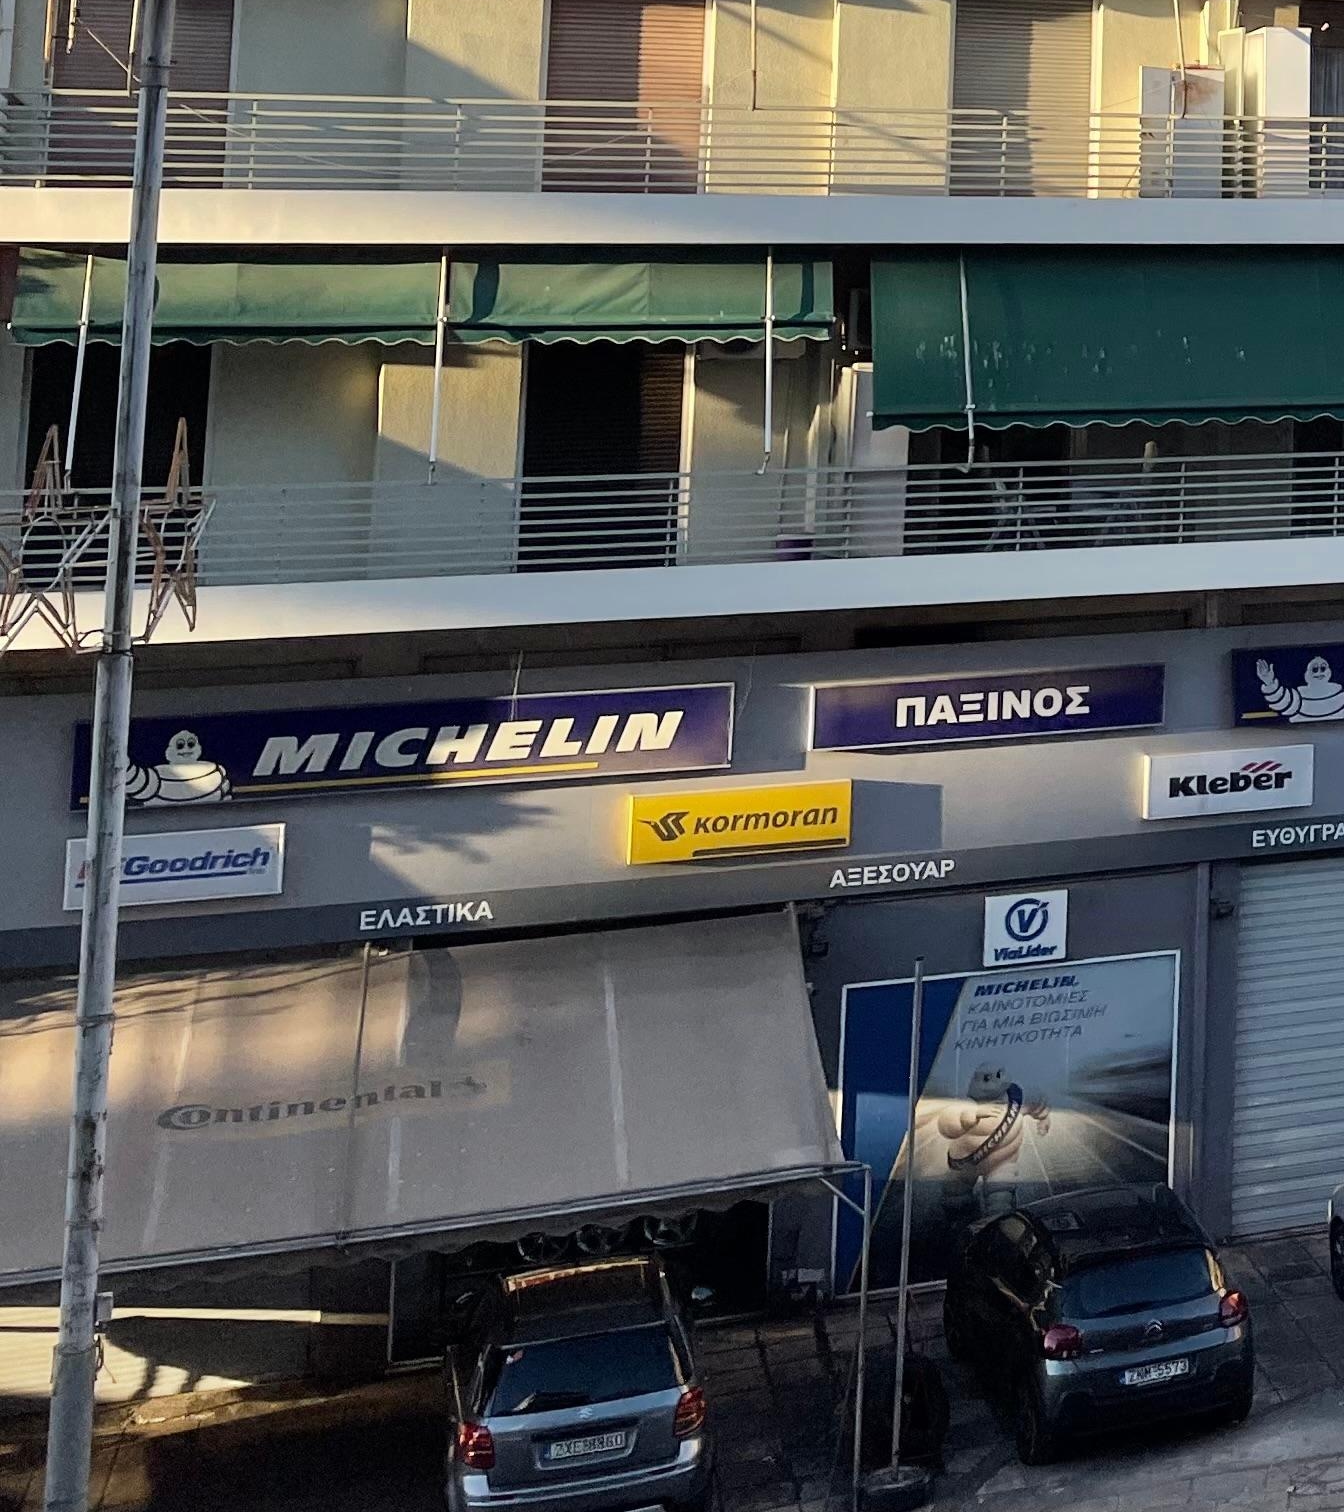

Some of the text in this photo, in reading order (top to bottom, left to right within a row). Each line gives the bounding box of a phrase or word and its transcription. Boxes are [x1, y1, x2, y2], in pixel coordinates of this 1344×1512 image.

[896, 686, 1090, 728] ΠΑΞΙΝΟΣ
[252, 710, 684, 777] MICHELIN
[1169, 771, 1292, 798] Kleber
[78, 847, 270, 880] Goodrich
[829, 859, 955, 888] ΑΞΕΣΟΥΑΡ
[359, 900, 494, 931] ΕΛΑΣΤΙΚΑ
[968, 989, 1089, 1014] ΚΑΙΝΟΤΟΜΙΕΣ
[954, 1025, 1082, 1050] ΚΙΝΗΤΙΚΟΤΗΤΑ
